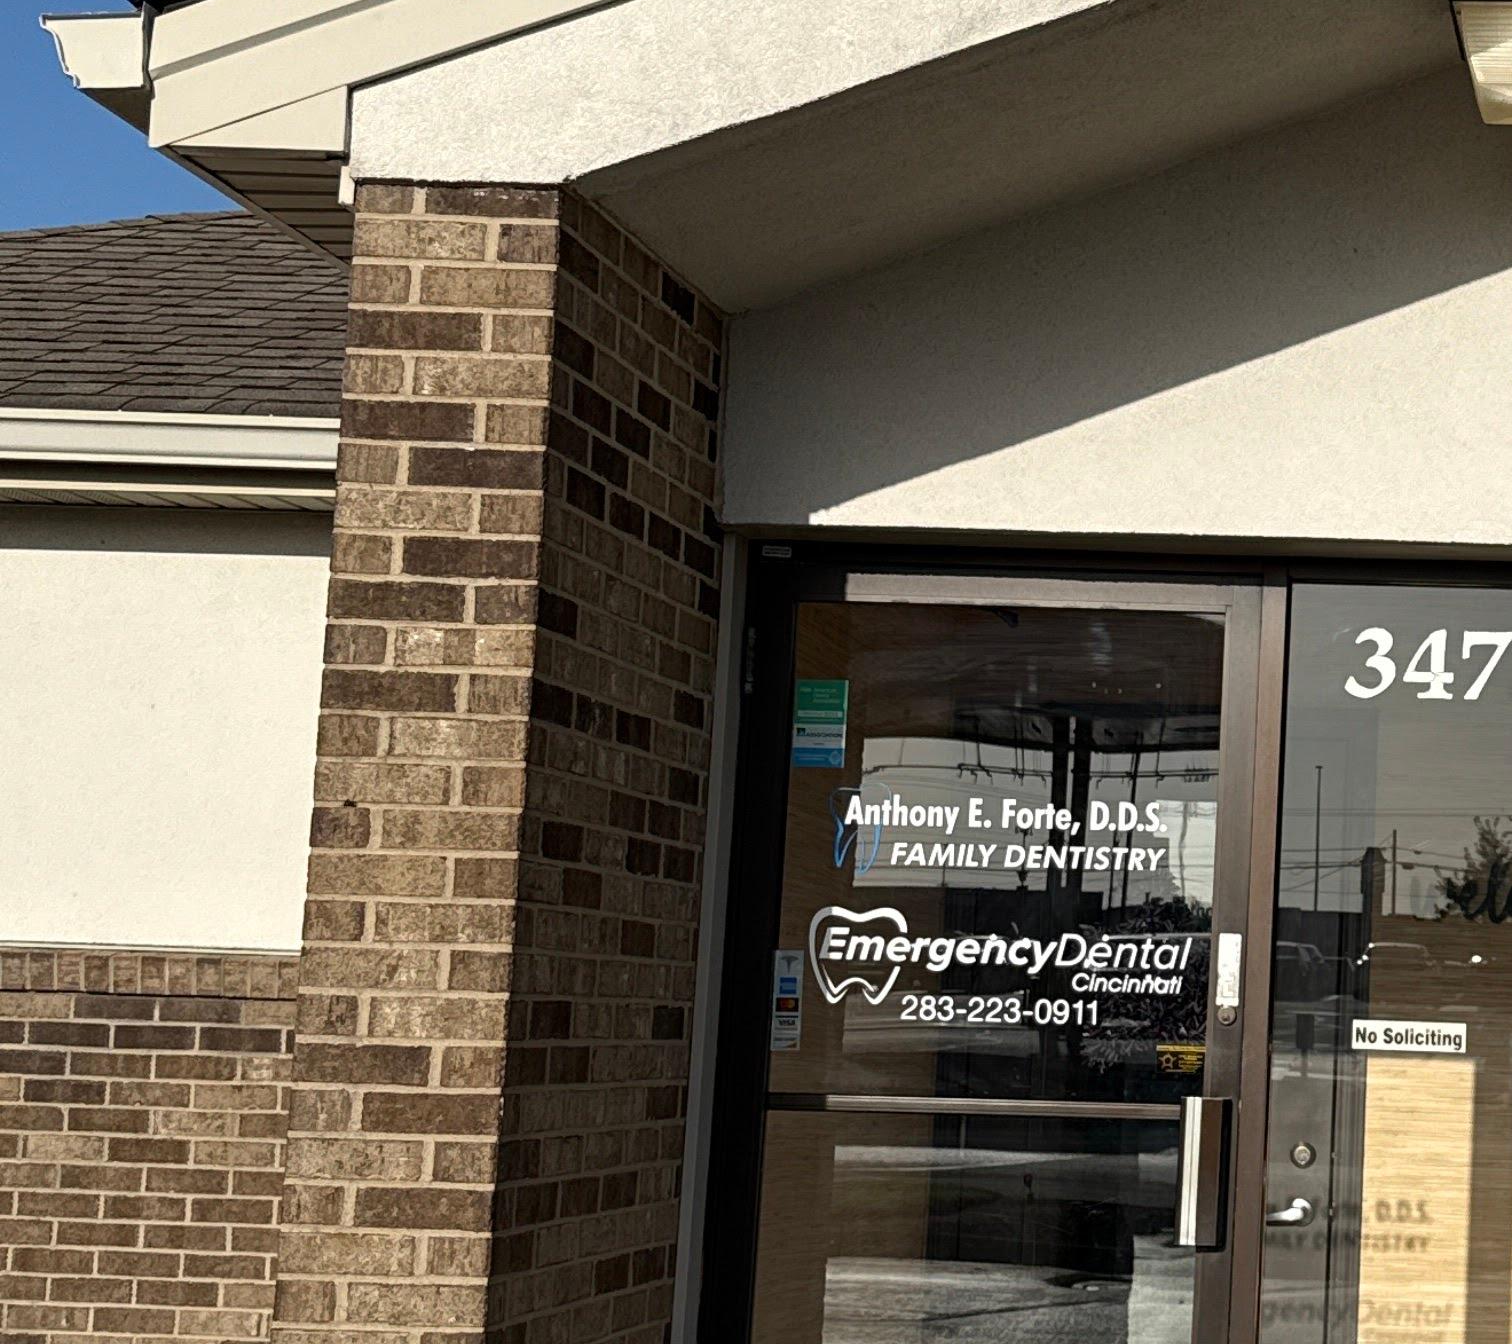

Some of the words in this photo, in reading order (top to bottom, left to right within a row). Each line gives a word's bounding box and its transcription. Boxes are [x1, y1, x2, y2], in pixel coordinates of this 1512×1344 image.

[844, 794, 960, 835] Anthony
[967, 798, 992, 828] E.
[1001, 799, 1082, 836] Forte,
[1089, 801, 1168, 833] D.D.S.
[890, 842, 997, 867] FAMILY
[1003, 845, 1167, 871] DENTISTRY
[1071, 972, 1183, 995] Cincinnati
[900, 994, 1099, 1026] 283-223-0911
[1355, 1027, 1378, 1044] No
[1383, 1028, 1463, 1051] Soliciting
